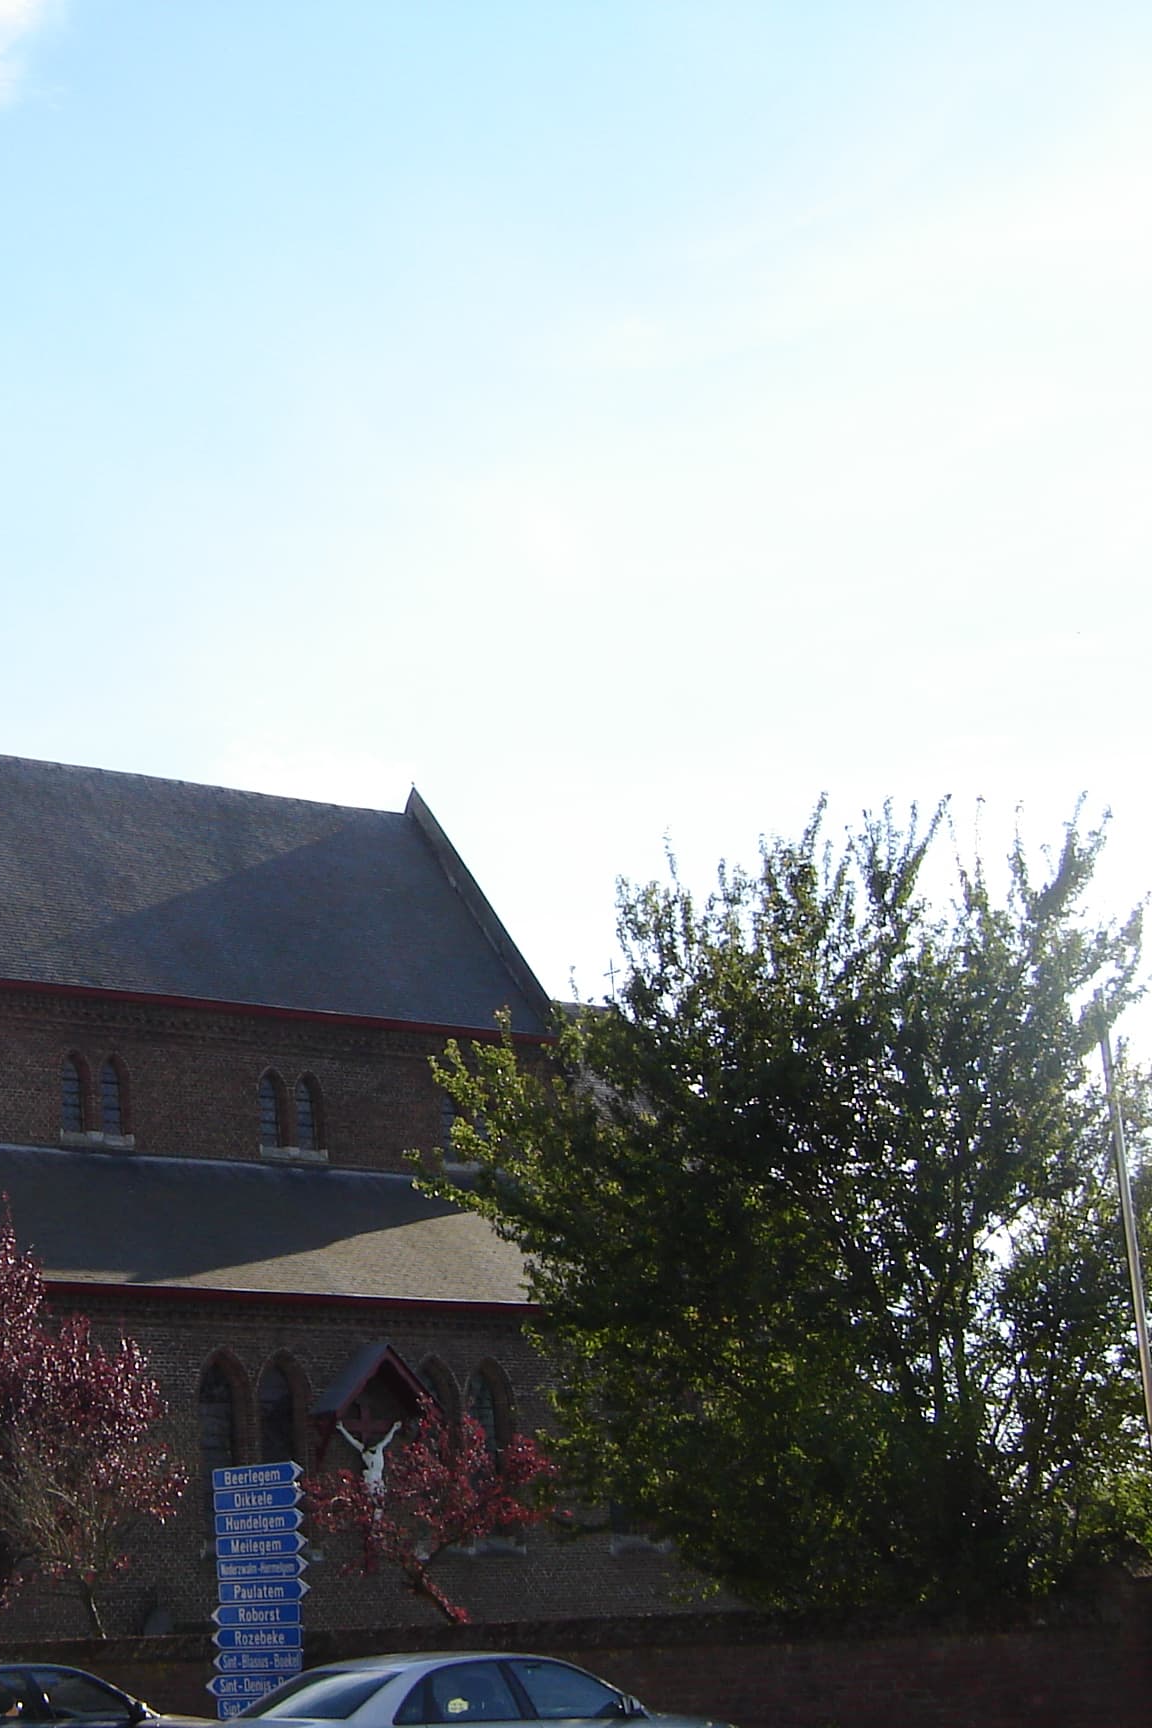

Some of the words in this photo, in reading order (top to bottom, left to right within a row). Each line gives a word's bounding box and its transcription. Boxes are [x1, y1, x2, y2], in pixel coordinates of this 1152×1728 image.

[224, 1469, 280, 1486] Beerlegem
[234, 1493, 273, 1508] Dikkele
[226, 1516, 285, 1532] Hundelgem
[232, 1539, 281, 1555] Meilegem
[234, 1584, 284, 1599] Paulatem
[238, 1607, 280, 1622] Roborst
[234, 1630, 285, 1647] Rozebeke
